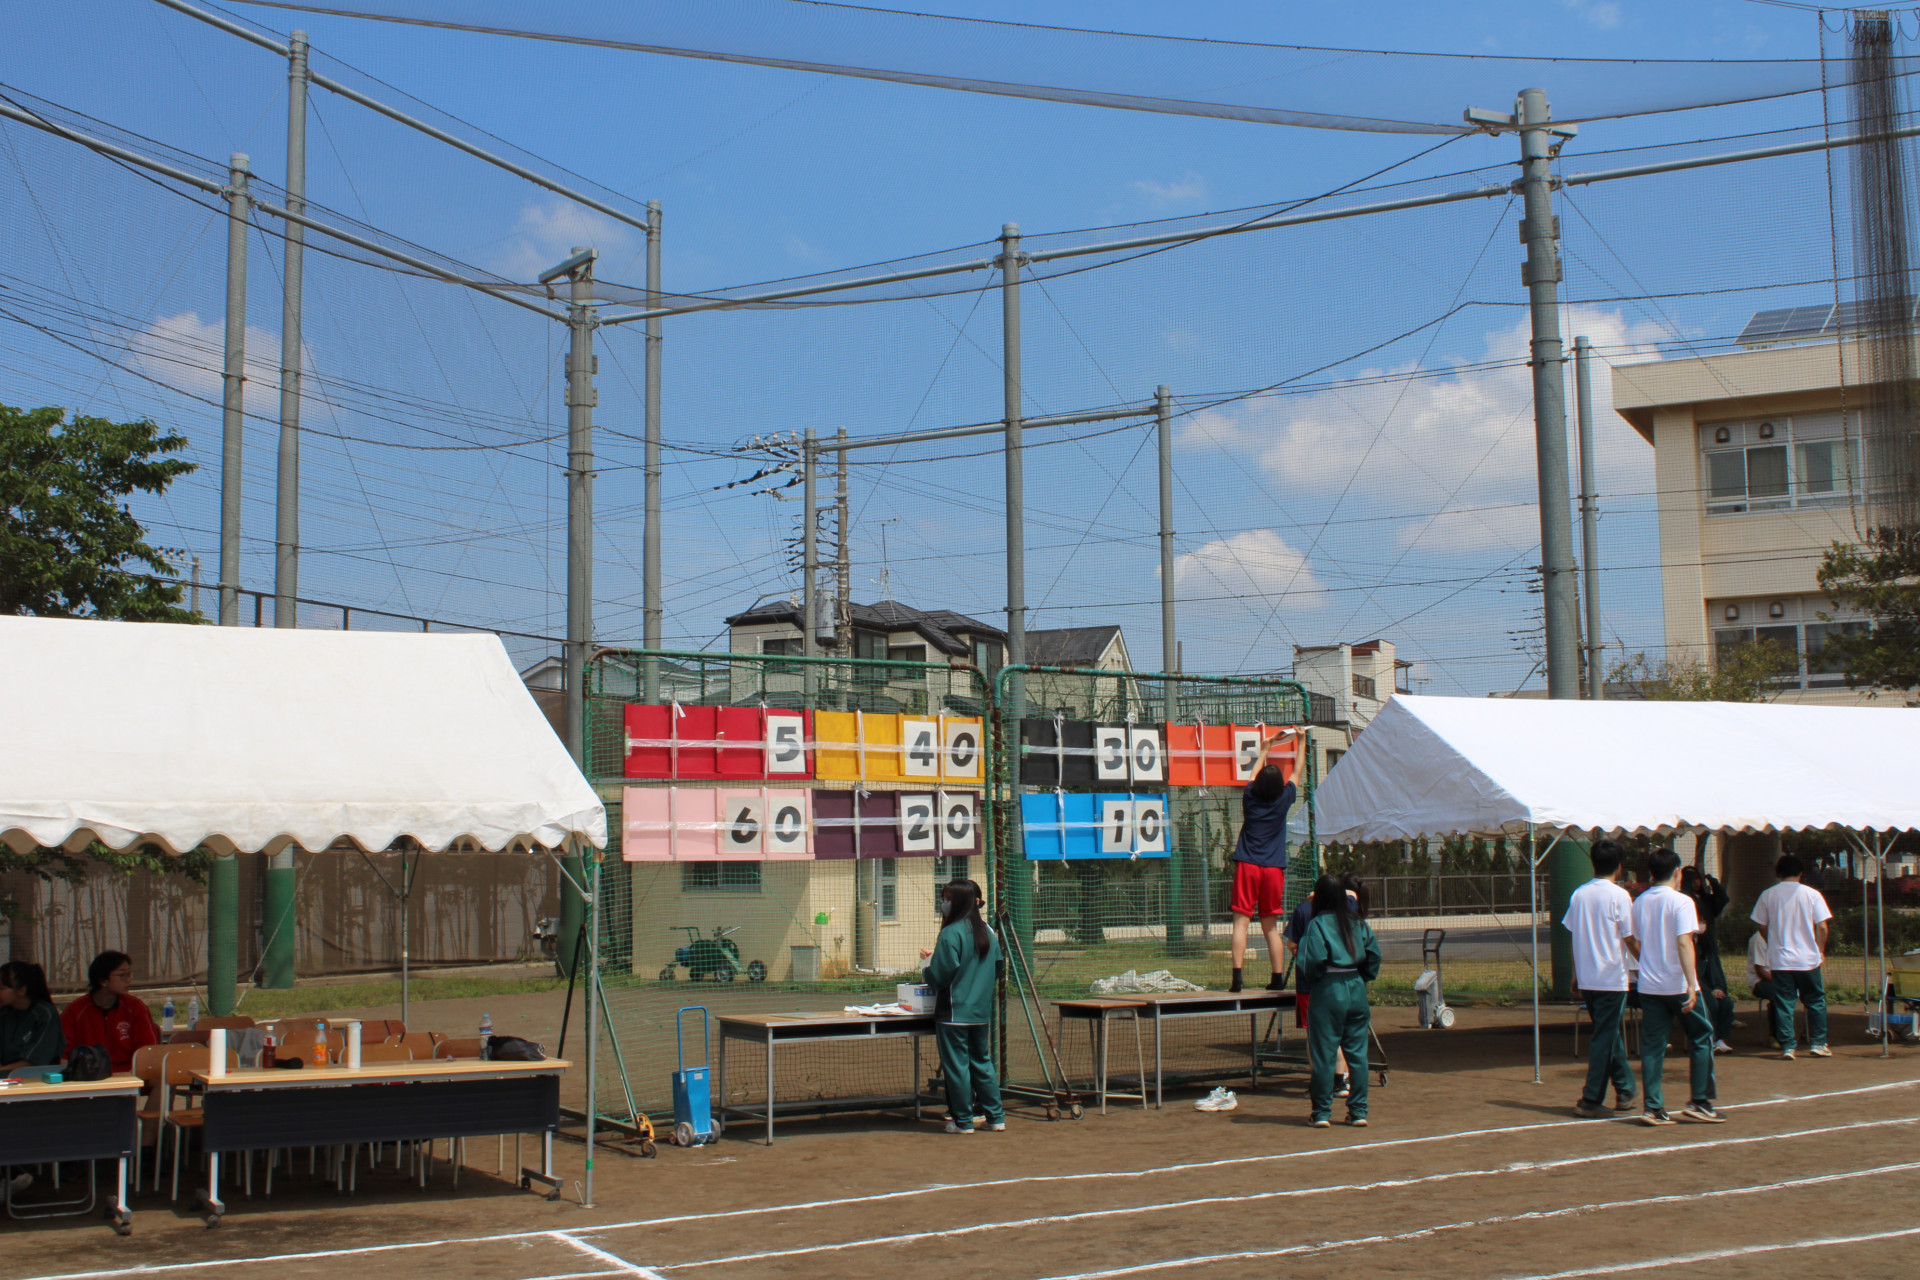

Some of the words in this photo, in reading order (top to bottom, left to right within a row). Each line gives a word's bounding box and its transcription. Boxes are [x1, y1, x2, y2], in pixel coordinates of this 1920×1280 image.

[775, 726, 800, 762] 5
[908, 730, 976, 768] 40
[1103, 737, 1156, 772] 30
[1240, 740, 1260, 772] 5
[731, 806, 801, 844] 60
[907, 804, 971, 840] 20
[1113, 809, 1160, 843] 10
